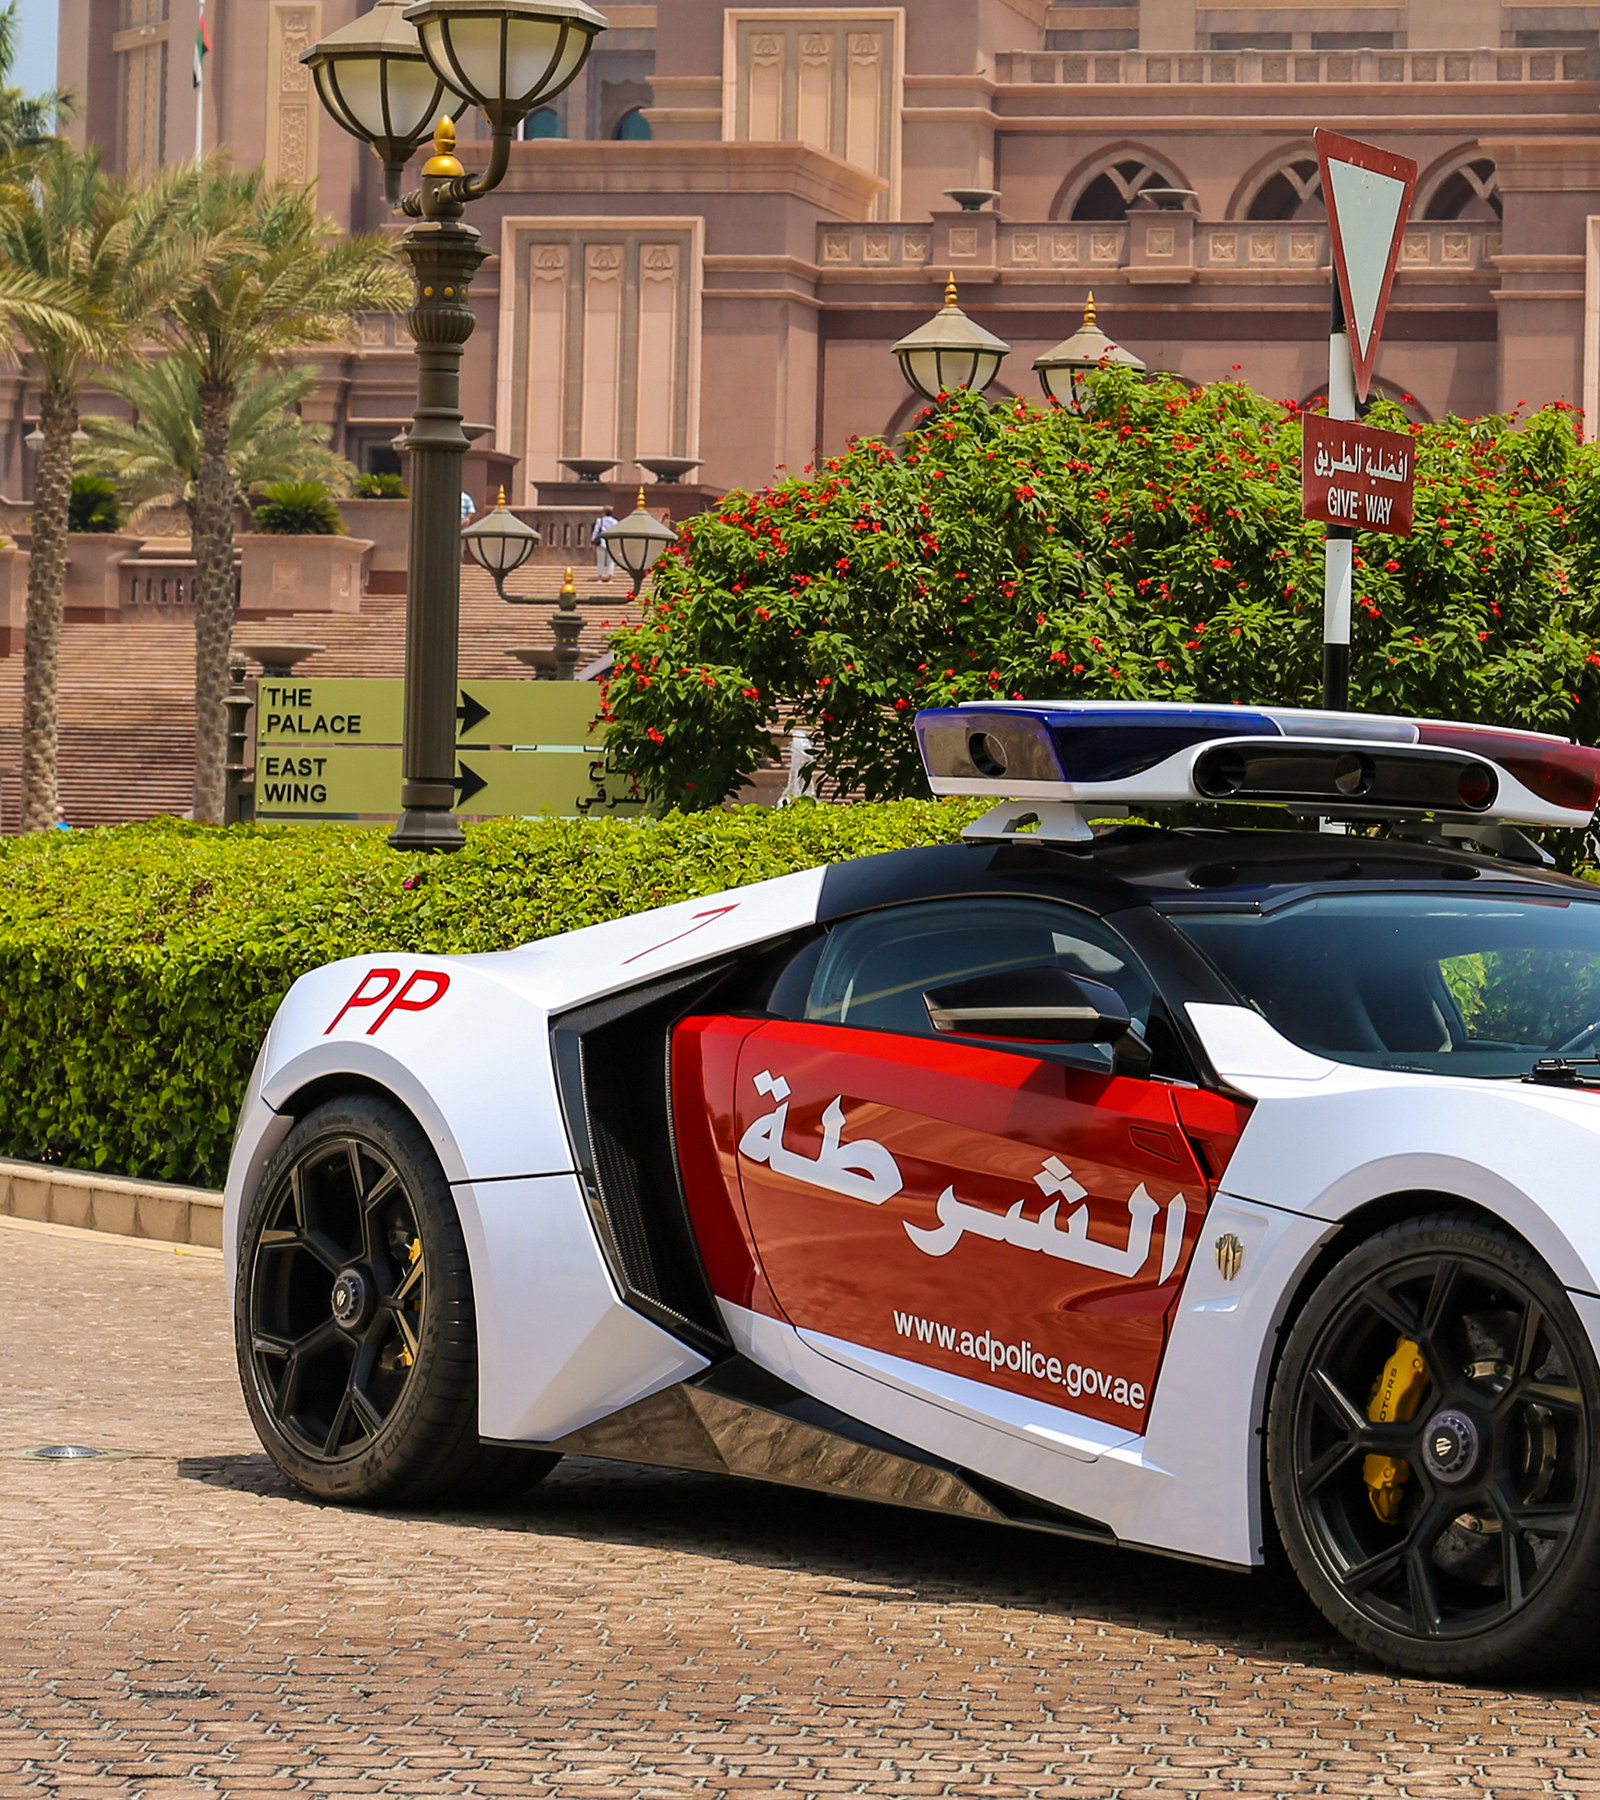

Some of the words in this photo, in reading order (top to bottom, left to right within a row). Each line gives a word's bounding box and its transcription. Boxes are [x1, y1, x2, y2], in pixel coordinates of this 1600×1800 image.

[1327, 486, 1359, 519] GIVE
[1365, 493, 1393, 525] WAY
[267, 688, 312, 707] THE
[267, 715, 361, 733] PALACE
[266, 758, 327, 776] EAST
[265, 785, 327, 803] WING
[323, 968, 451, 1035] PP
[738, 1069, 1188, 1286] الشرطة
[893, 1309, 1145, 1410] www.adpolice.gov.ae
[1379, 1367, 1397, 1421] OTORS
